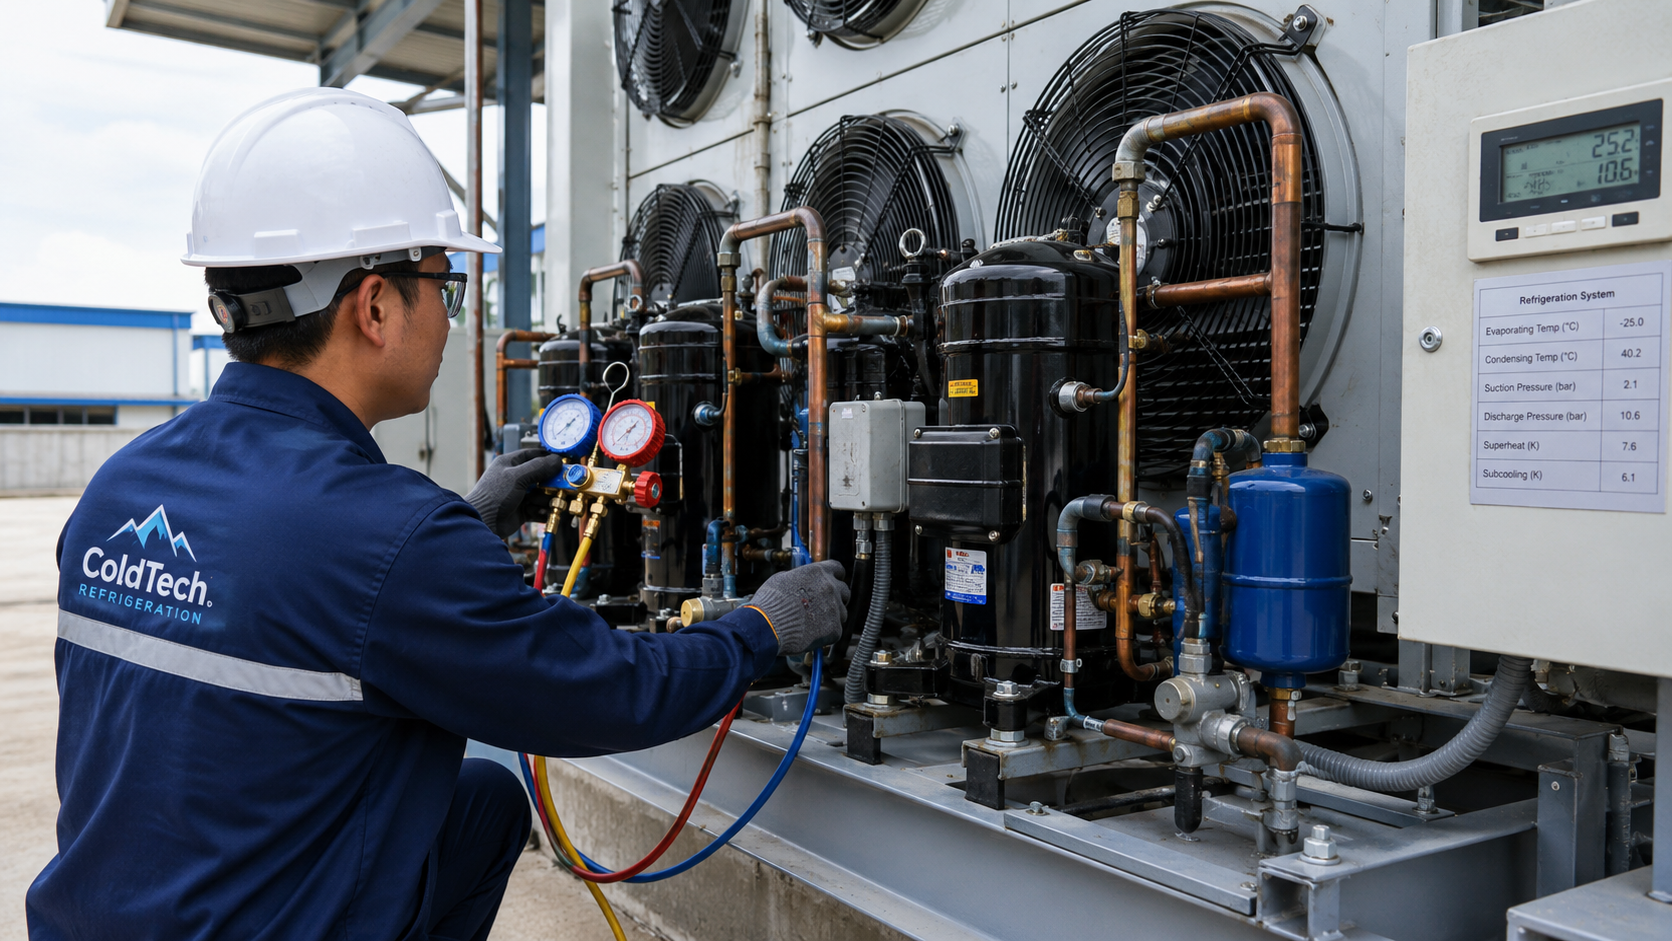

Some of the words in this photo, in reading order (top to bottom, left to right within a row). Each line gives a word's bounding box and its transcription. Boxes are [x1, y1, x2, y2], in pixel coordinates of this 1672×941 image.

[1598, 157, 1633, 184] 10.6
[1519, 292, 1578, 305] Refrigeration
[1580, 289, 1615, 302] System
[1619, 317, 1644, 328] -25.0
[1486, 326, 1534, 336] Evaporating
[1536, 323, 1560, 333] Temp
[1562, 321, 1579, 332] (°C)
[1485, 354, 1533, 365] Condensing
[1535, 353, 1558, 363] Temp
[1560, 351, 1578, 362] (°C)
[1621, 348, 1642, 358] 40.2
[1484, 383, 1515, 392] Suction
[1517, 382, 1553, 391] Pressure
[1555, 381, 1576, 392] (bar)
[1623, 380, 1638, 389] 2.1
[1484, 412, 1524, 422] Discharge
[1526, 412, 1564, 421] Pressure
[1566, 411, 1587, 422] (bar)
[1620, 411, 1641, 420] 10.6
[1483, 441, 1525, 451] Superheat
[1527, 441, 1540, 451] (K)
[1622, 442, 1637, 451] 7.6
[1483, 469, 1528, 480] Subcooling
[1530, 470, 1543, 480] (K)
[1621, 473, 1635, 482] 6.1
[78, 583, 202, 625] REFRIGERATION
